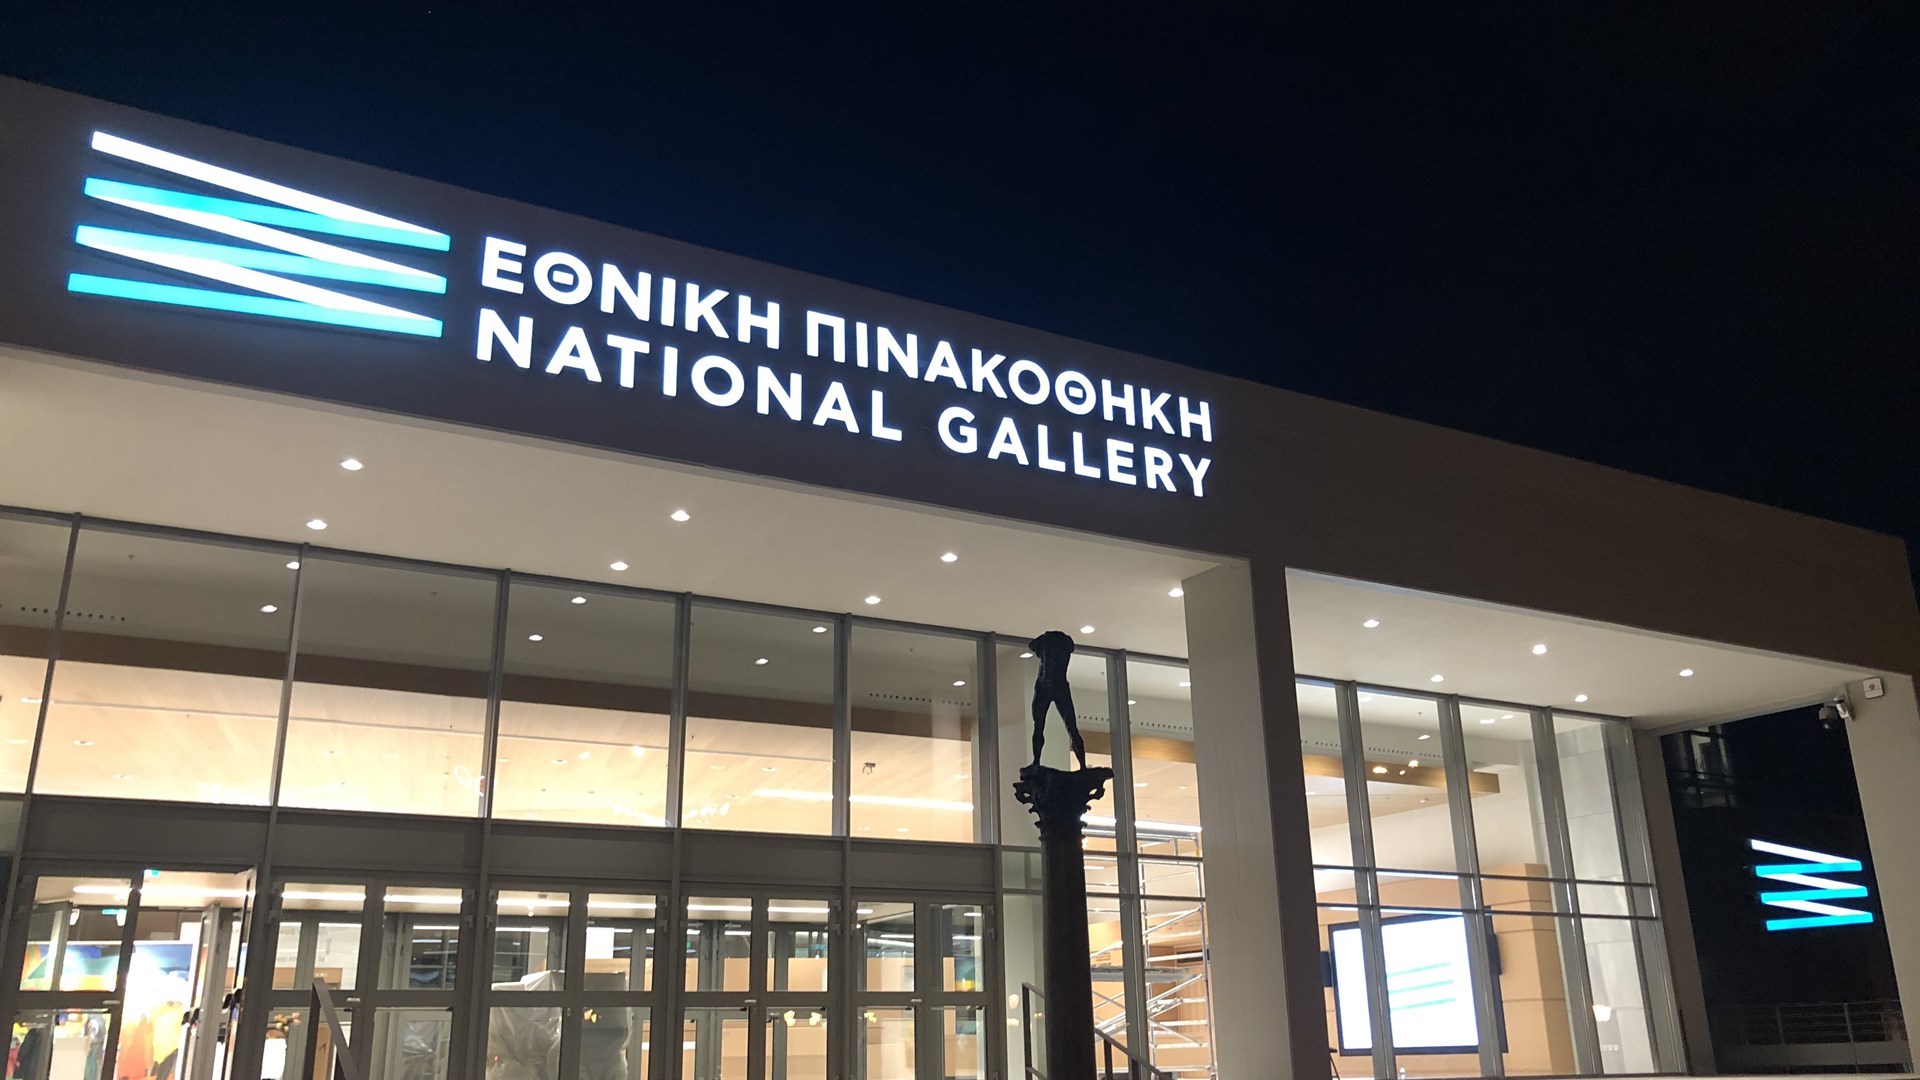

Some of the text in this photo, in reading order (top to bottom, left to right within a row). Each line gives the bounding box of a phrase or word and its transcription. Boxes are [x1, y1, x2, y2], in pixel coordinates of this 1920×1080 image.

[476, 307, 1212, 498] NATIONAL GALLERY
[481, 236, 1213, 443] ΕΘΝΙΚΗ ΠΙΝΑΚΟΘΗΚΗ
